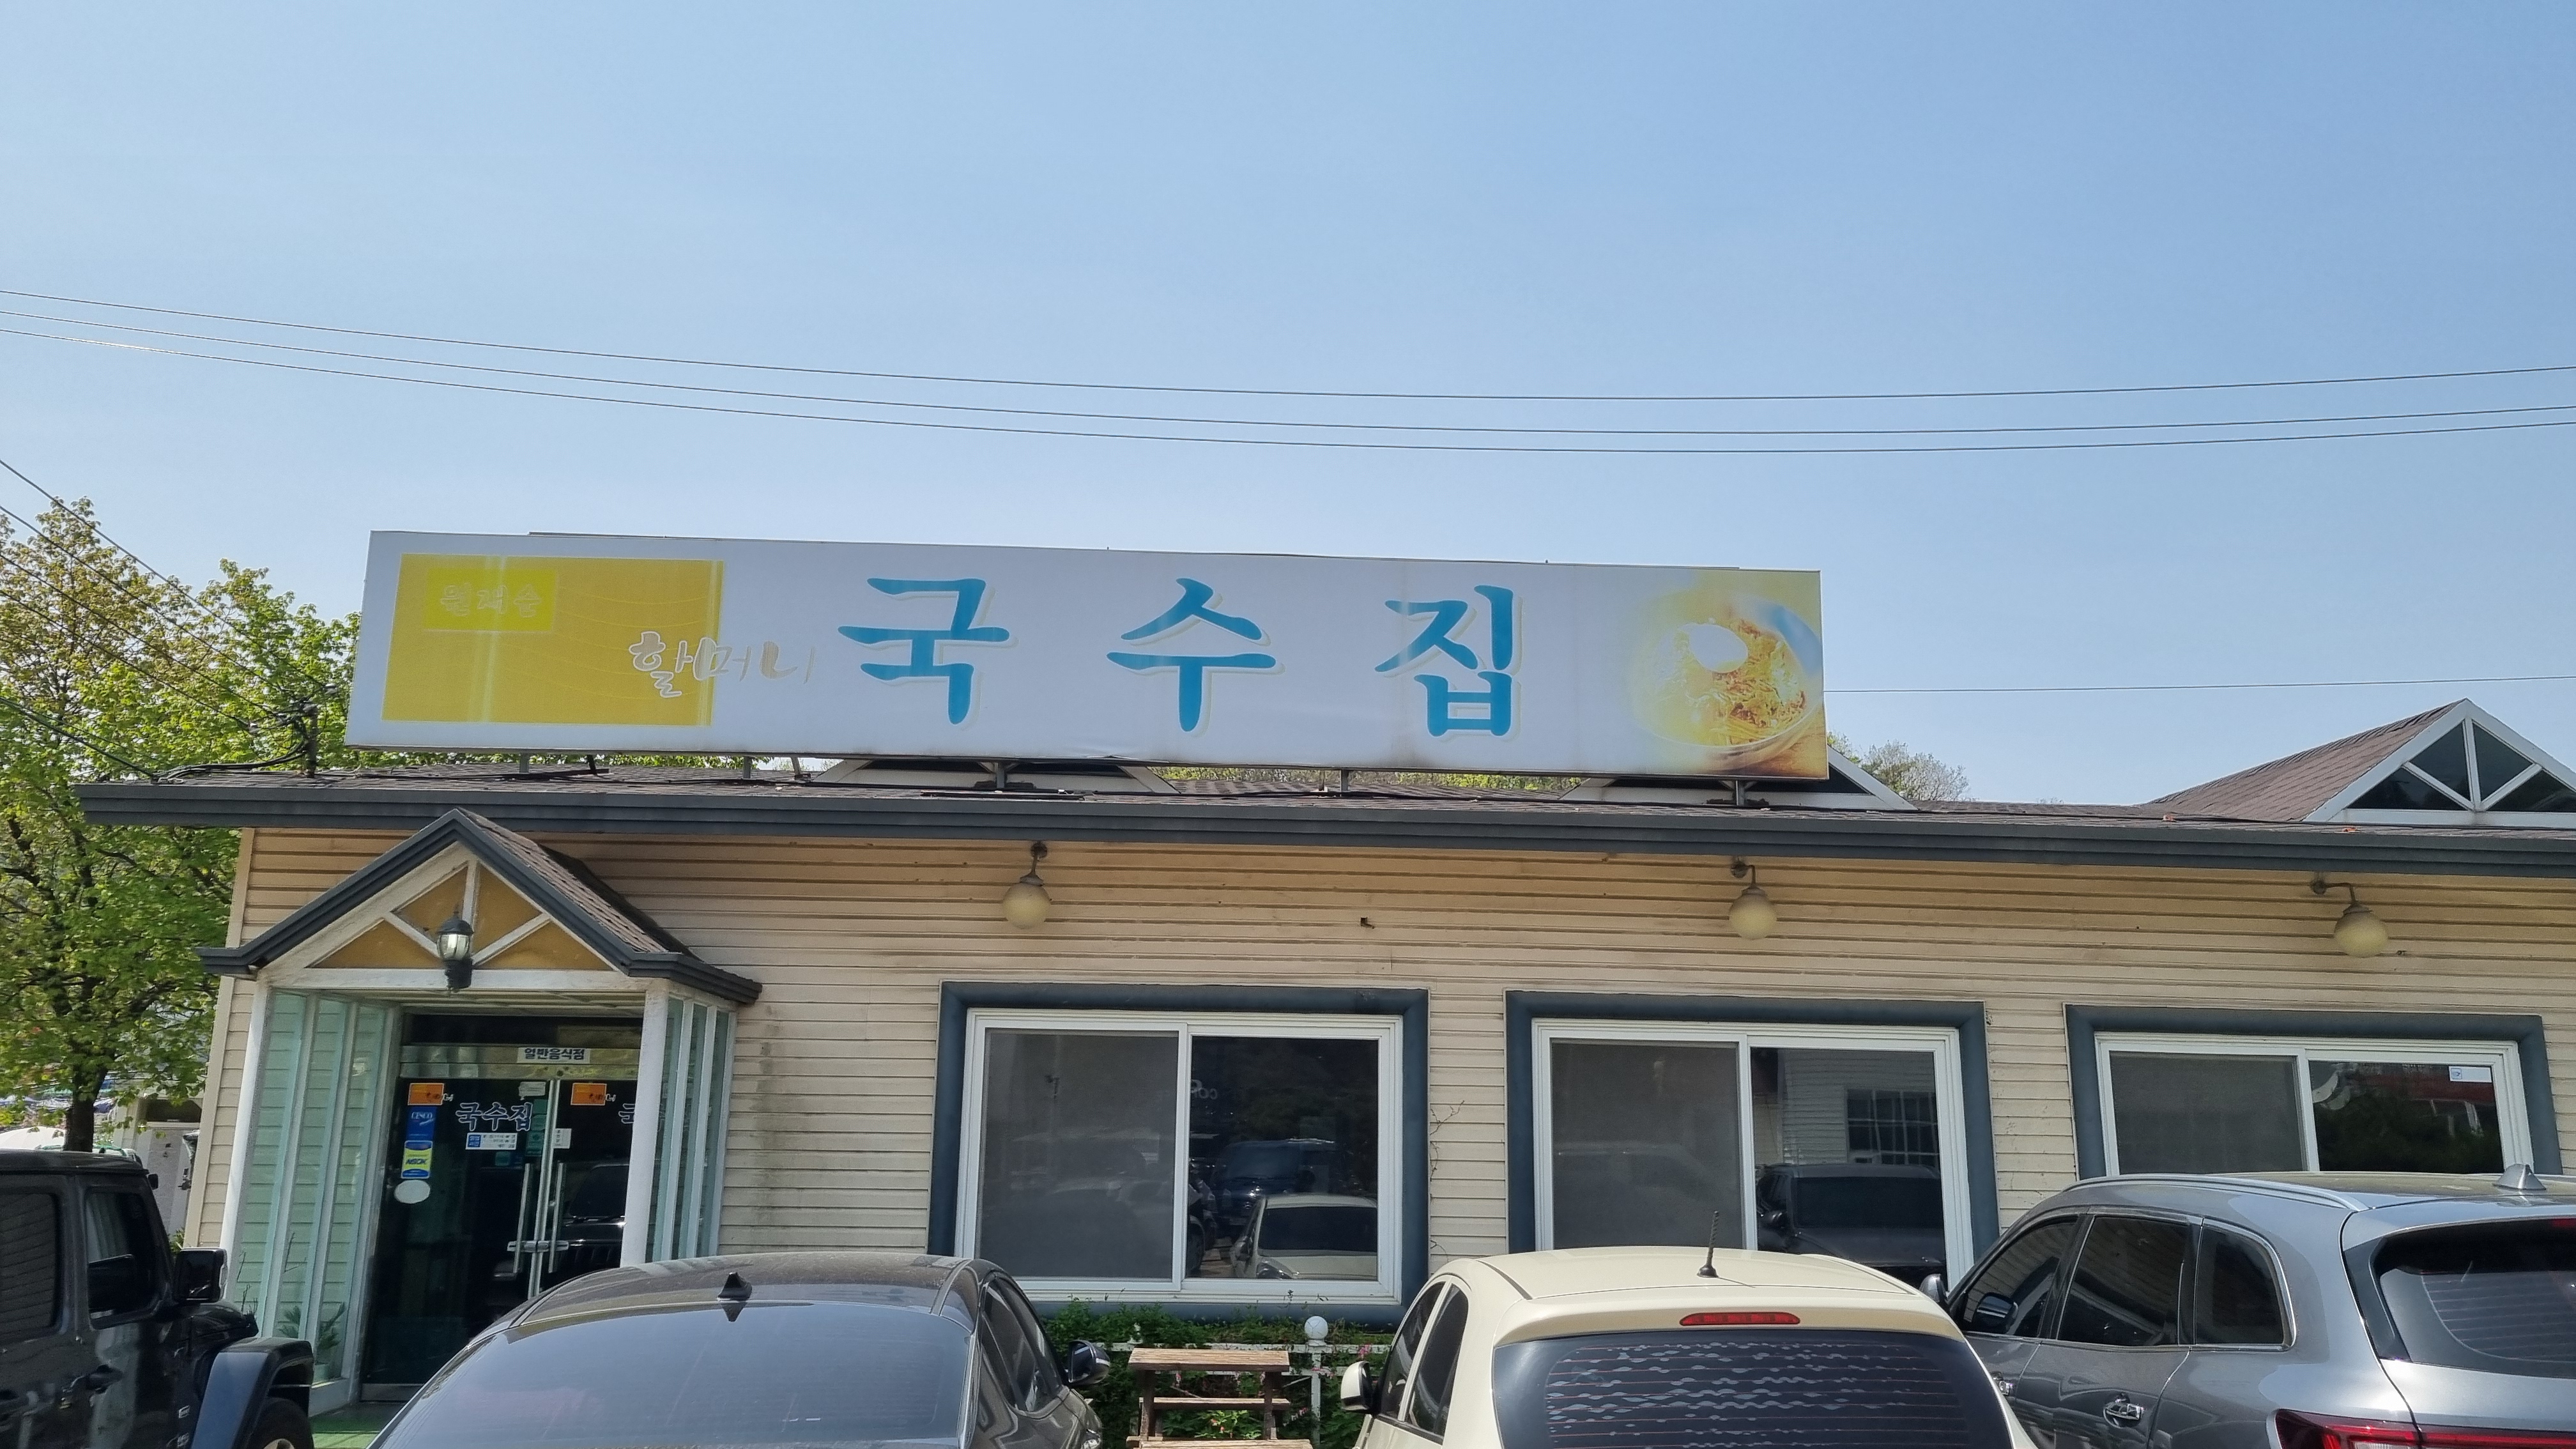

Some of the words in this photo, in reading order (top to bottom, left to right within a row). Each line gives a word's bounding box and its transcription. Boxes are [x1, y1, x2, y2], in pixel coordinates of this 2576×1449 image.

[628, 630, 816, 698] 할머니
[525, 1047, 585, 1061] 일반음식점
[456, 1102, 533, 1131] 국수집
